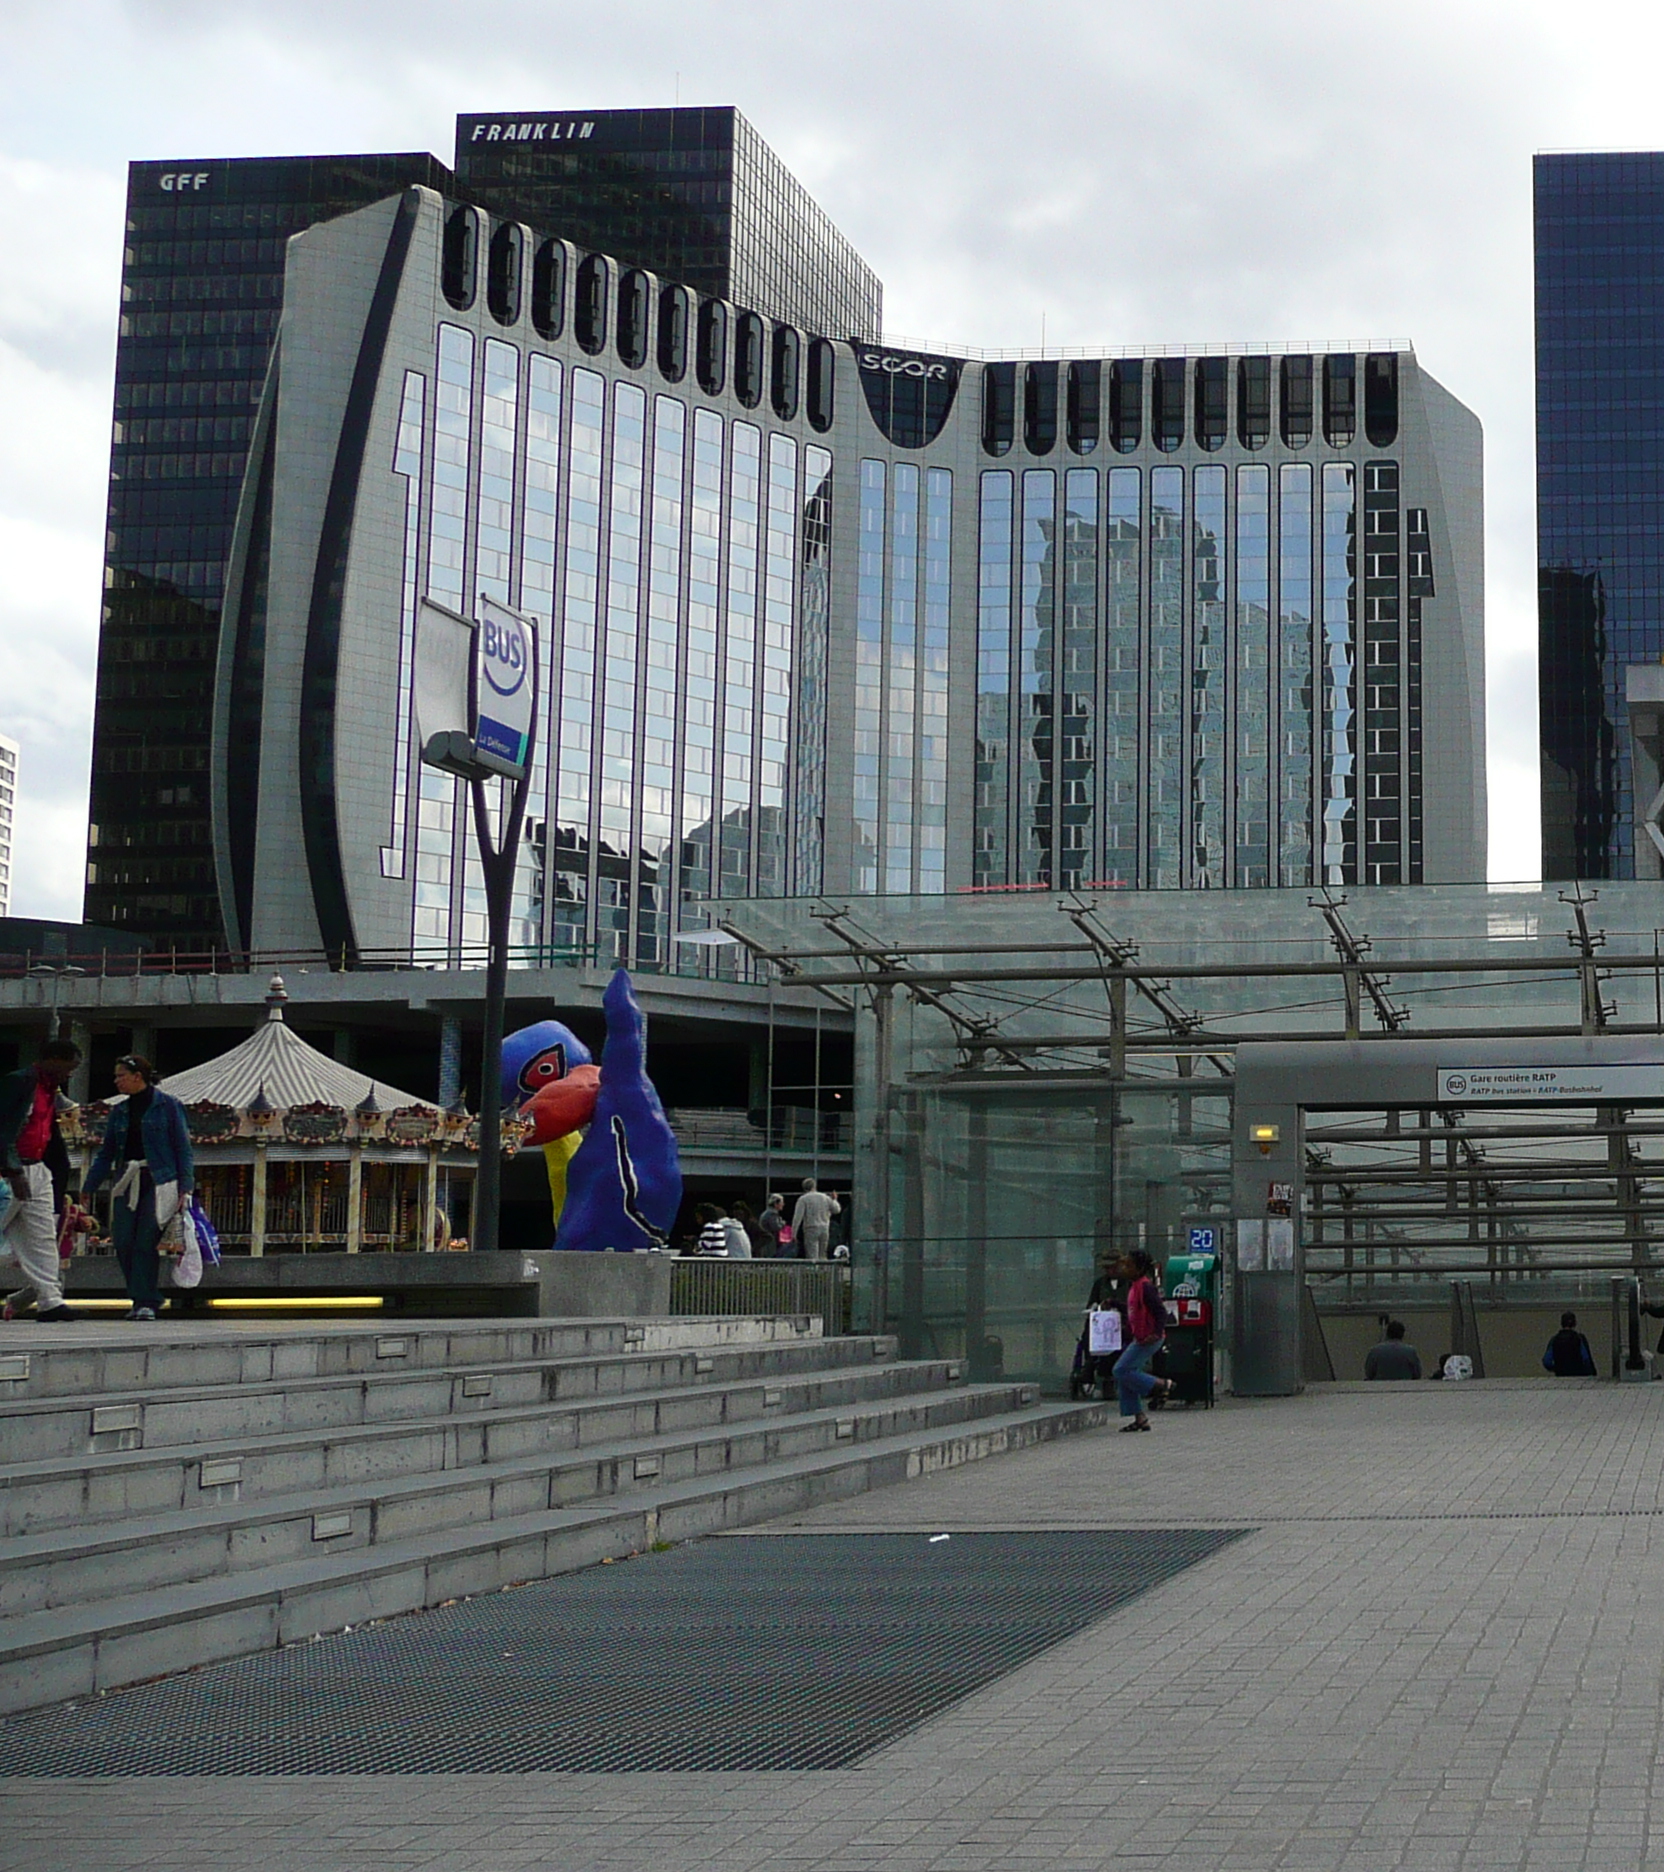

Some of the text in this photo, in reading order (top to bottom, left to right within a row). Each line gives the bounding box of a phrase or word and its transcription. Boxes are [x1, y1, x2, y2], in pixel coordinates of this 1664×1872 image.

[471, 122, 596, 142] FRANKLIN
[160, 173, 210, 191] GFF
[862, 354, 947, 380] SCOR
[485, 619, 521, 668] BUS
[1449, 1081, 1465, 1090] BUS
[1470, 1073, 1557, 1083] Gare routière RATP
[1191, 1229, 1213, 1248] 20
